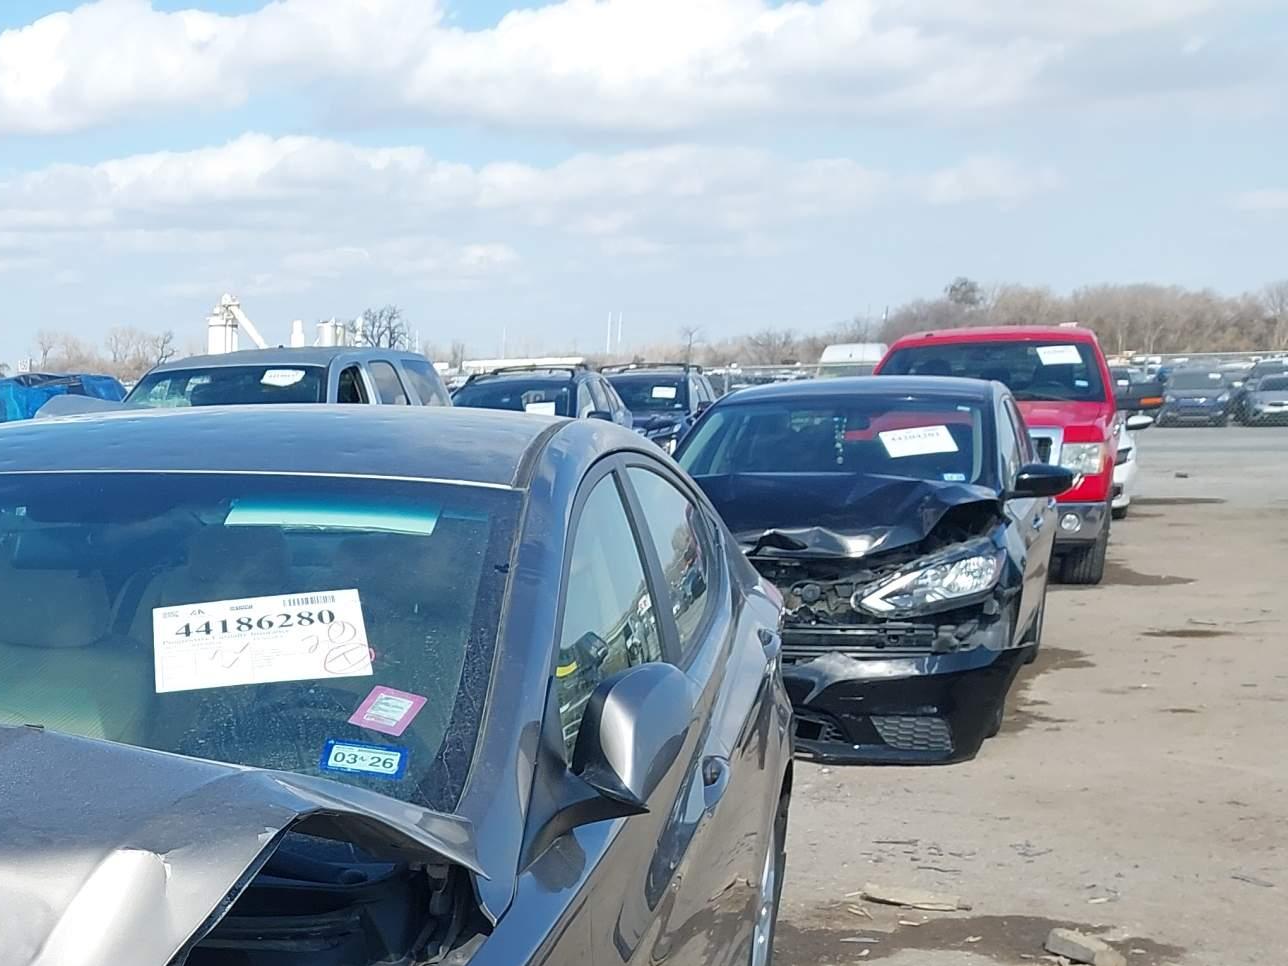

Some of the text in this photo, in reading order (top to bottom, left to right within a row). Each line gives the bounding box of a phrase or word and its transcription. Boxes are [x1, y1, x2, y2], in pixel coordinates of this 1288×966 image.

[175, 608, 336, 638] 44186280
[333, 751, 359, 765] 03
[367, 755, 395, 770] 26
